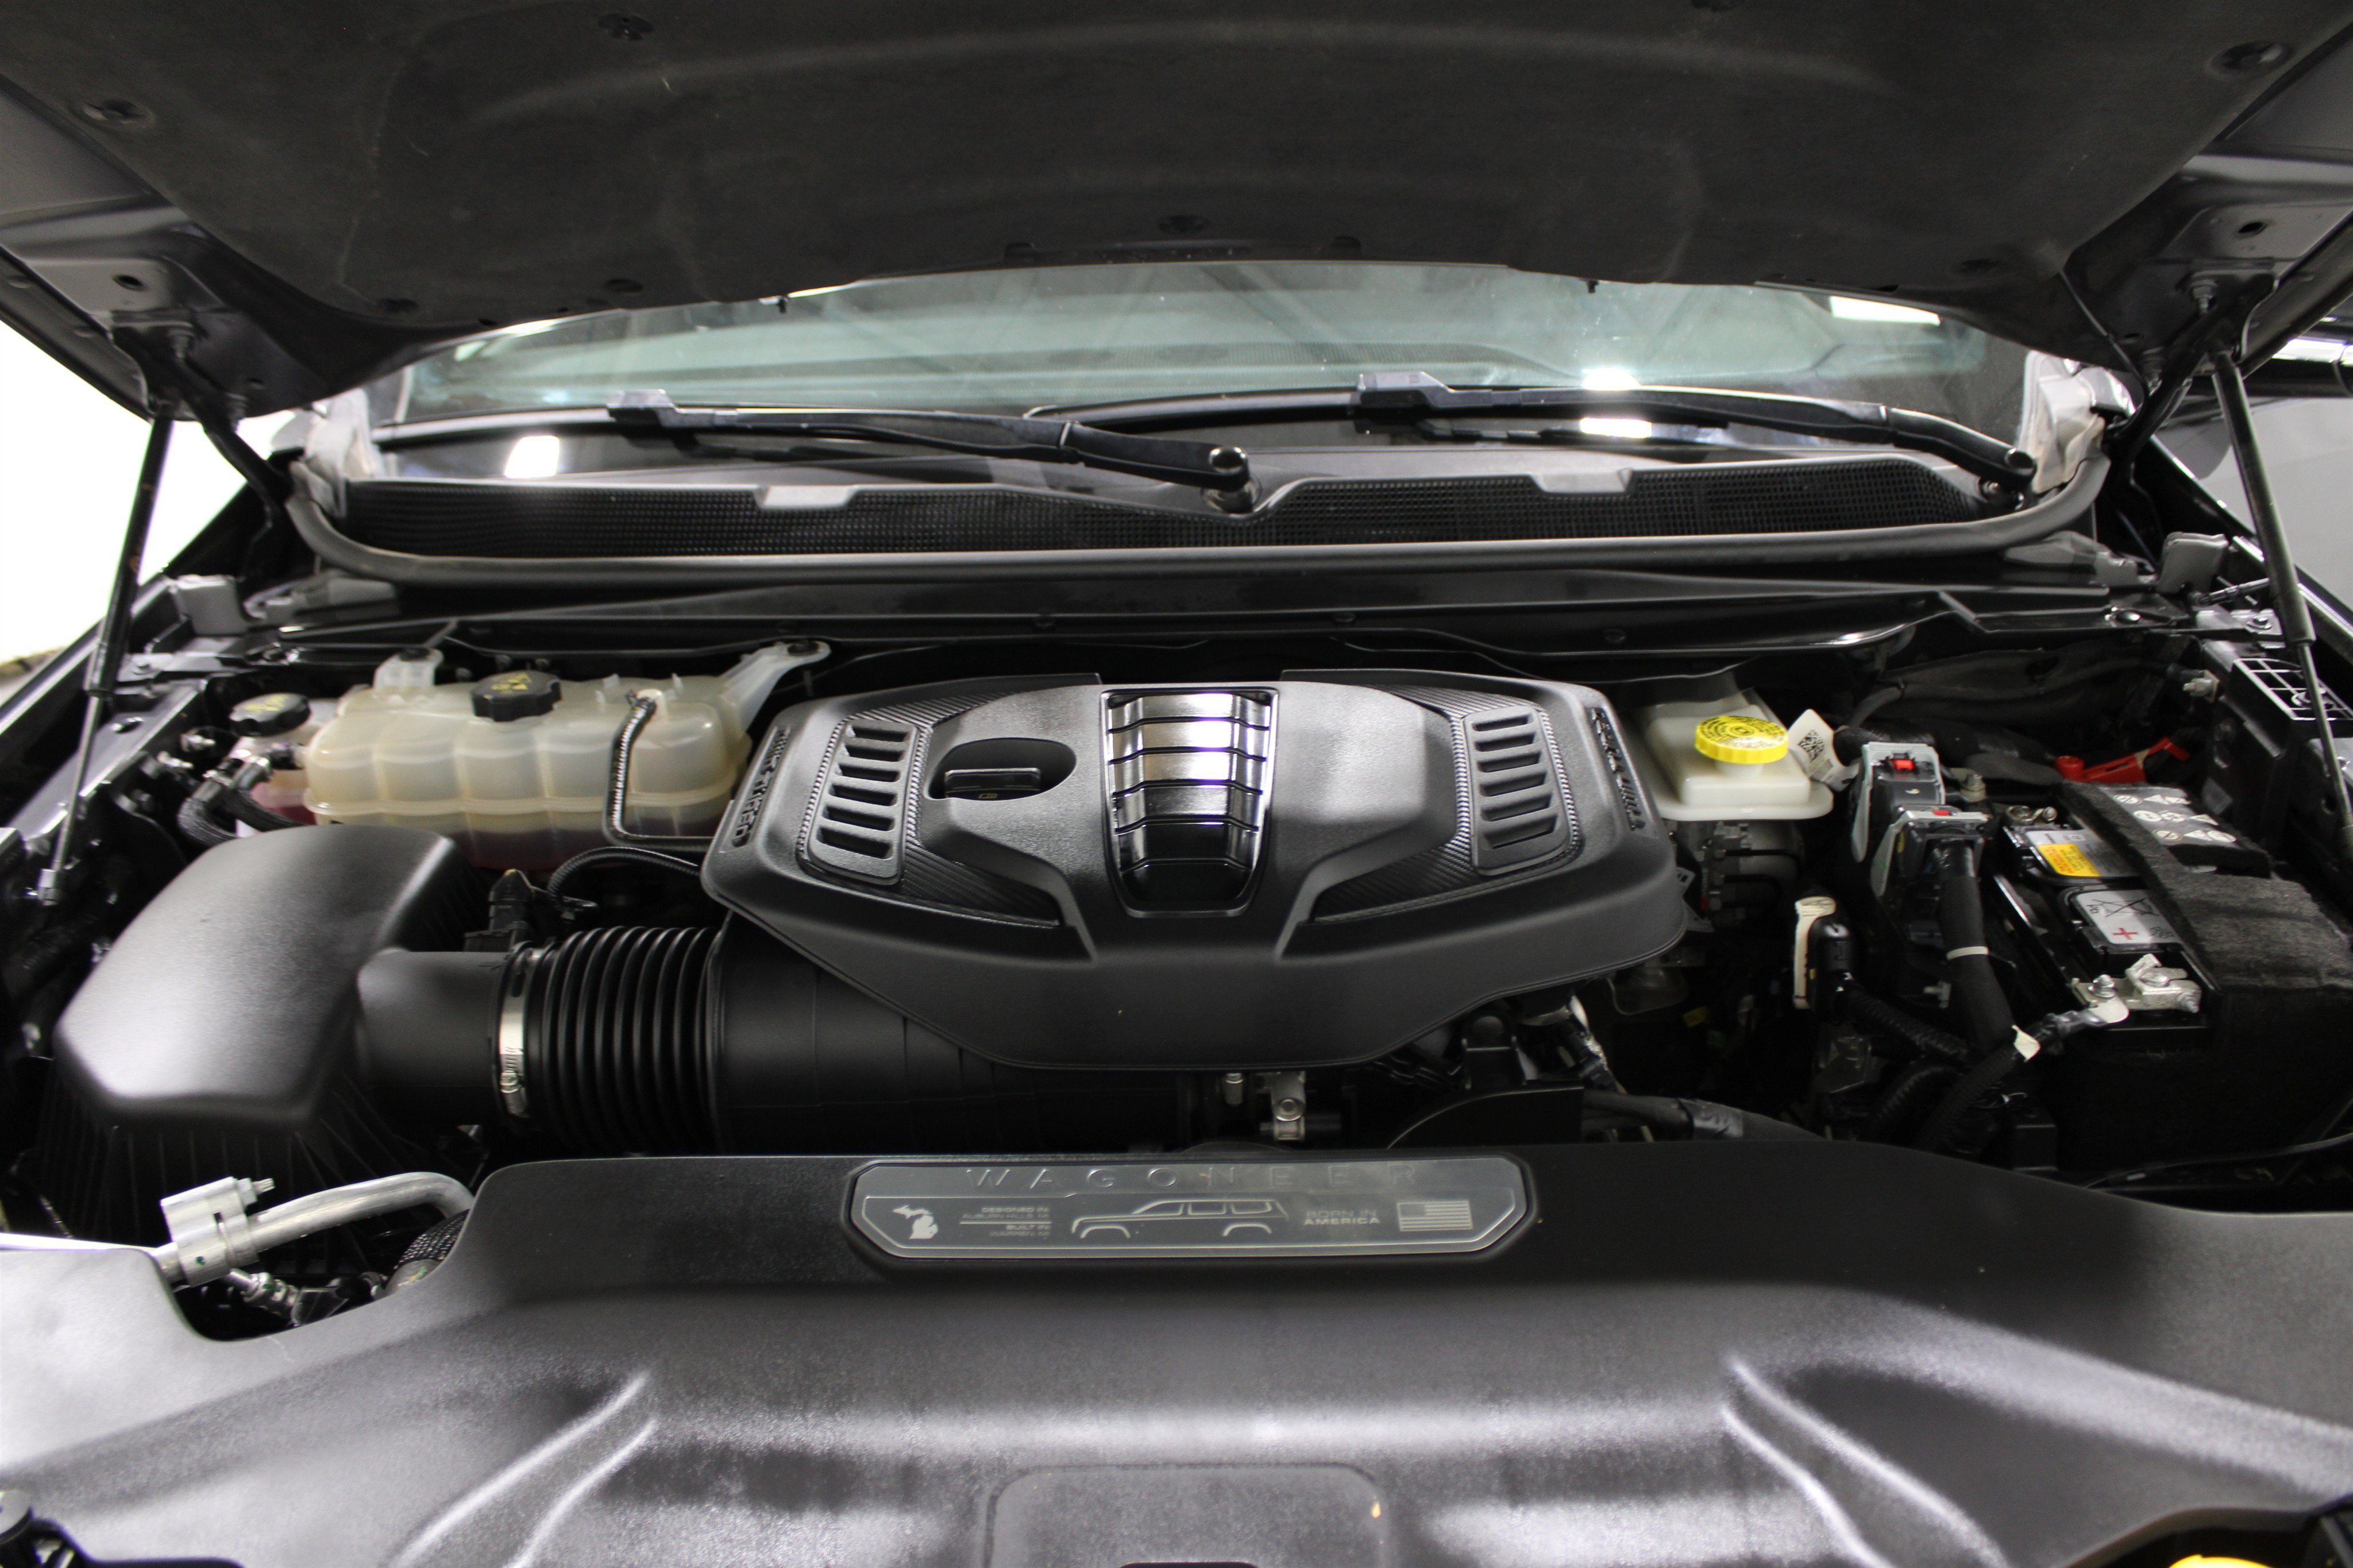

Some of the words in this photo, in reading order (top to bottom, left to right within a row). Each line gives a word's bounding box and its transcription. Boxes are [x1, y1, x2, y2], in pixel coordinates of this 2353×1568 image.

[734, 771, 772, 840] TURBO
[966, 1164, 1417, 1189] WAGONEER
[1303, 1217, 1380, 1225] AMERICA
